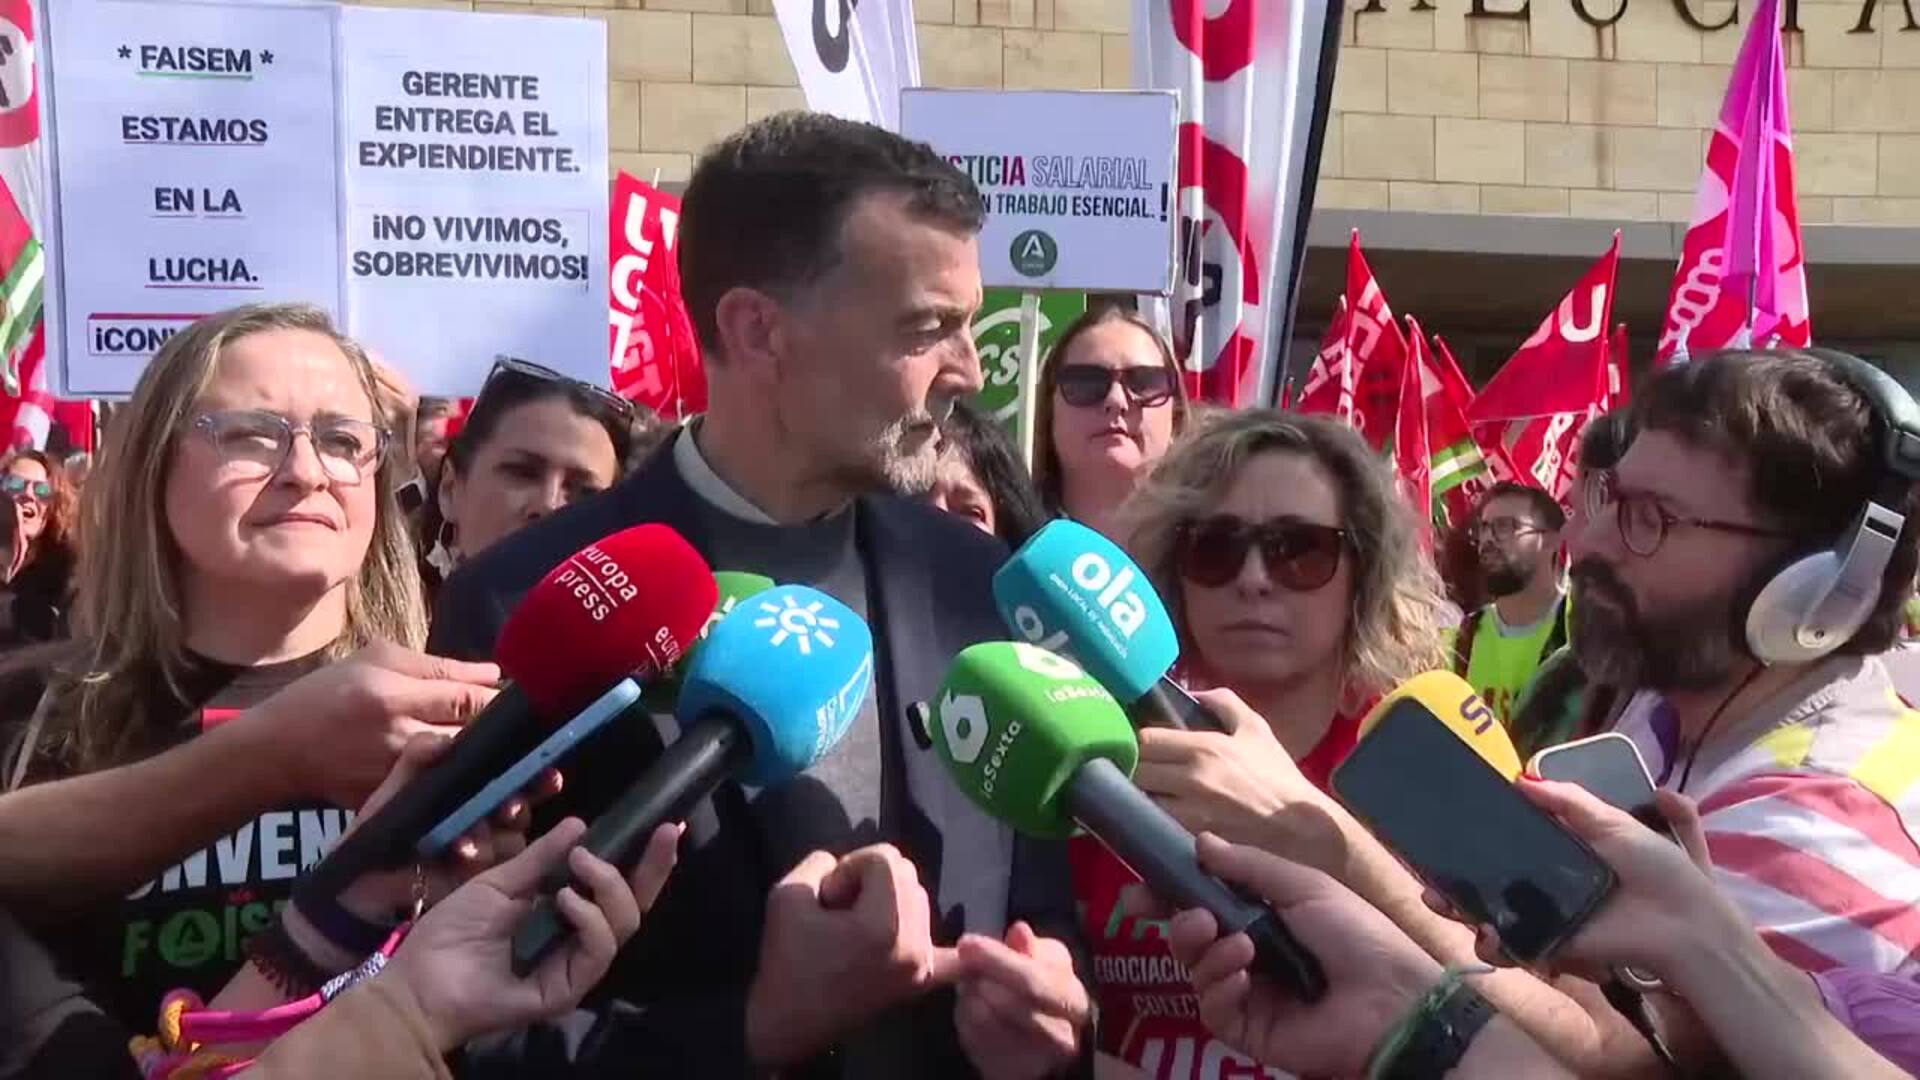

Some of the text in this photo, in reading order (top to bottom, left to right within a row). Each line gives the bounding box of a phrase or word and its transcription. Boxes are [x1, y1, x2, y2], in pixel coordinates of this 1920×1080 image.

[140, 45, 252, 73] FAISEM
[402, 70, 539, 101] GERENTE
[121, 115, 268, 143] ESTAMOS
[375, 105, 558, 136] ENTREGA EL
[359, 141, 581, 173] EXPIENDIENTE.
[1031, 155, 1153, 190] SALARIAL
[154, 187, 243, 213] EN LA
[997, 194, 1068, 216] TRABAJO
[1072, 196, 1156, 219] ESENCIAL.
[433, 216, 569, 249] VIVIMOS,
[149, 257, 259, 282] LUCHA.
[352, 250, 589, 280] SOBREVIVIMOS!
[95, 327, 177, 352] ¡CON
[554, 569, 610, 620] press
[1072, 552, 1146, 640] ola
